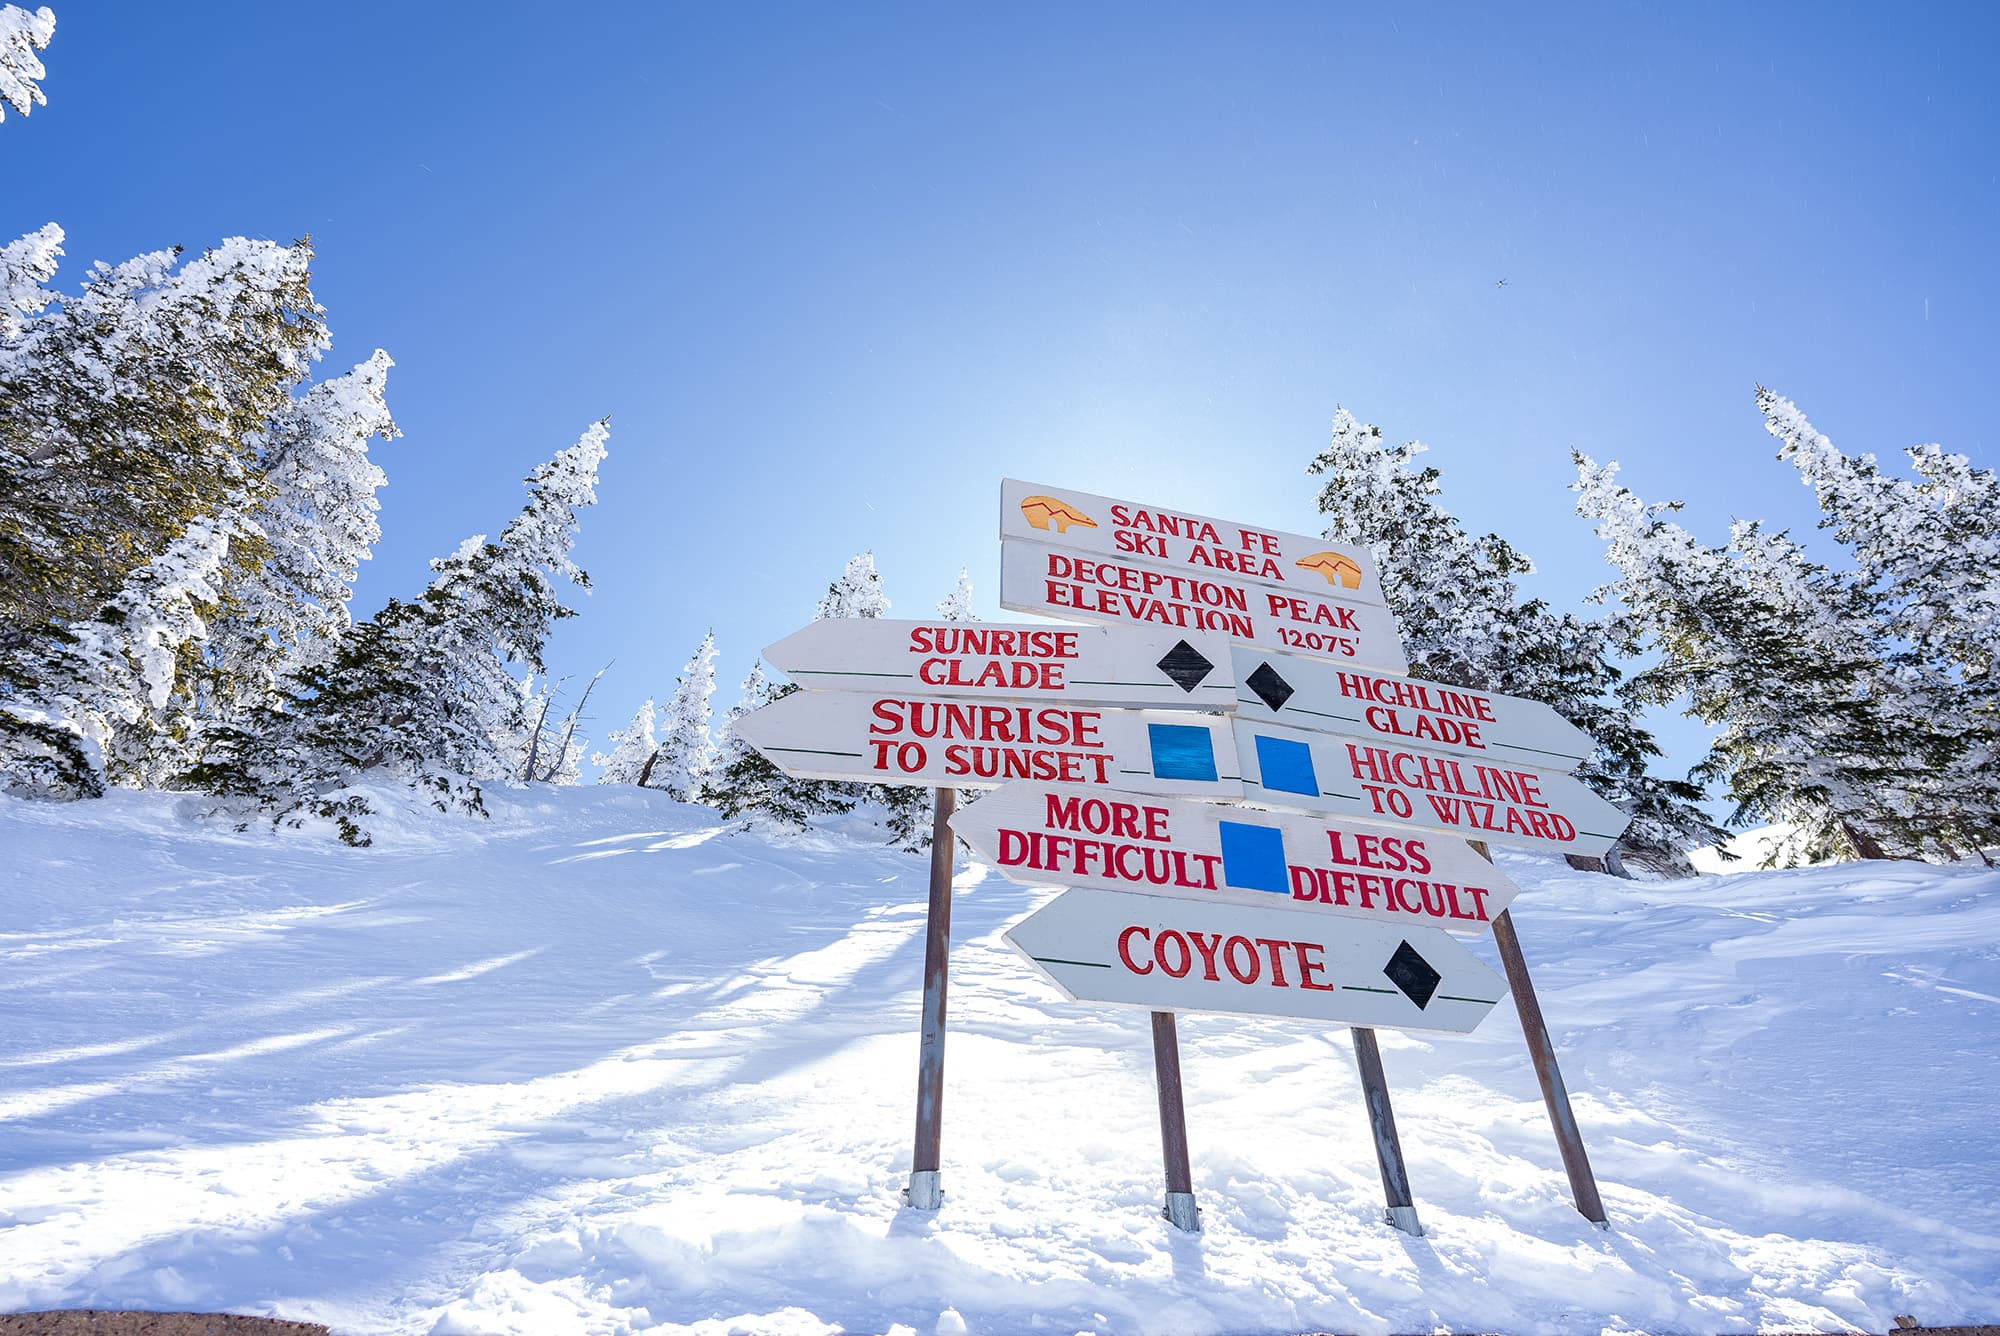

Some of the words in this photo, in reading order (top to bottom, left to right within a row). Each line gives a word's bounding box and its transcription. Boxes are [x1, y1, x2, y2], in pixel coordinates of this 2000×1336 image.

[1111, 504, 1222, 545] SANTA
[1238, 529, 1282, 557] FE
[1115, 529, 1169, 559] SKI
[1187, 545, 1284, 581] AREA
[1045, 579, 1255, 639] ELEVATION
[1047, 553, 1248, 612] DECEPTION
[1265, 593, 1361, 632] PEAK
[909, 626, 1079, 659] SUNRISE
[919, 657, 1065, 690] GLADE
[1337, 671, 1496, 723] HIGHLINE
[869, 698, 1105, 749] SUNRISE
[1366, 705, 1487, 750] GLADE
[869, 739, 928, 774] TO
[944, 744, 1114, 785] SUNSET
[1345, 743, 1549, 809] HIGHLINE
[1044, 793, 1172, 843] MORE
[1361, 784, 1413, 819] TO
[1426, 794, 1576, 842] WIZARD
[996, 828, 1222, 891] DIFFICULT
[1327, 830, 1432, 875] LESS
[1287, 864, 1490, 922] DIFFICULT
[1117, 925, 1334, 992] COYOTE
